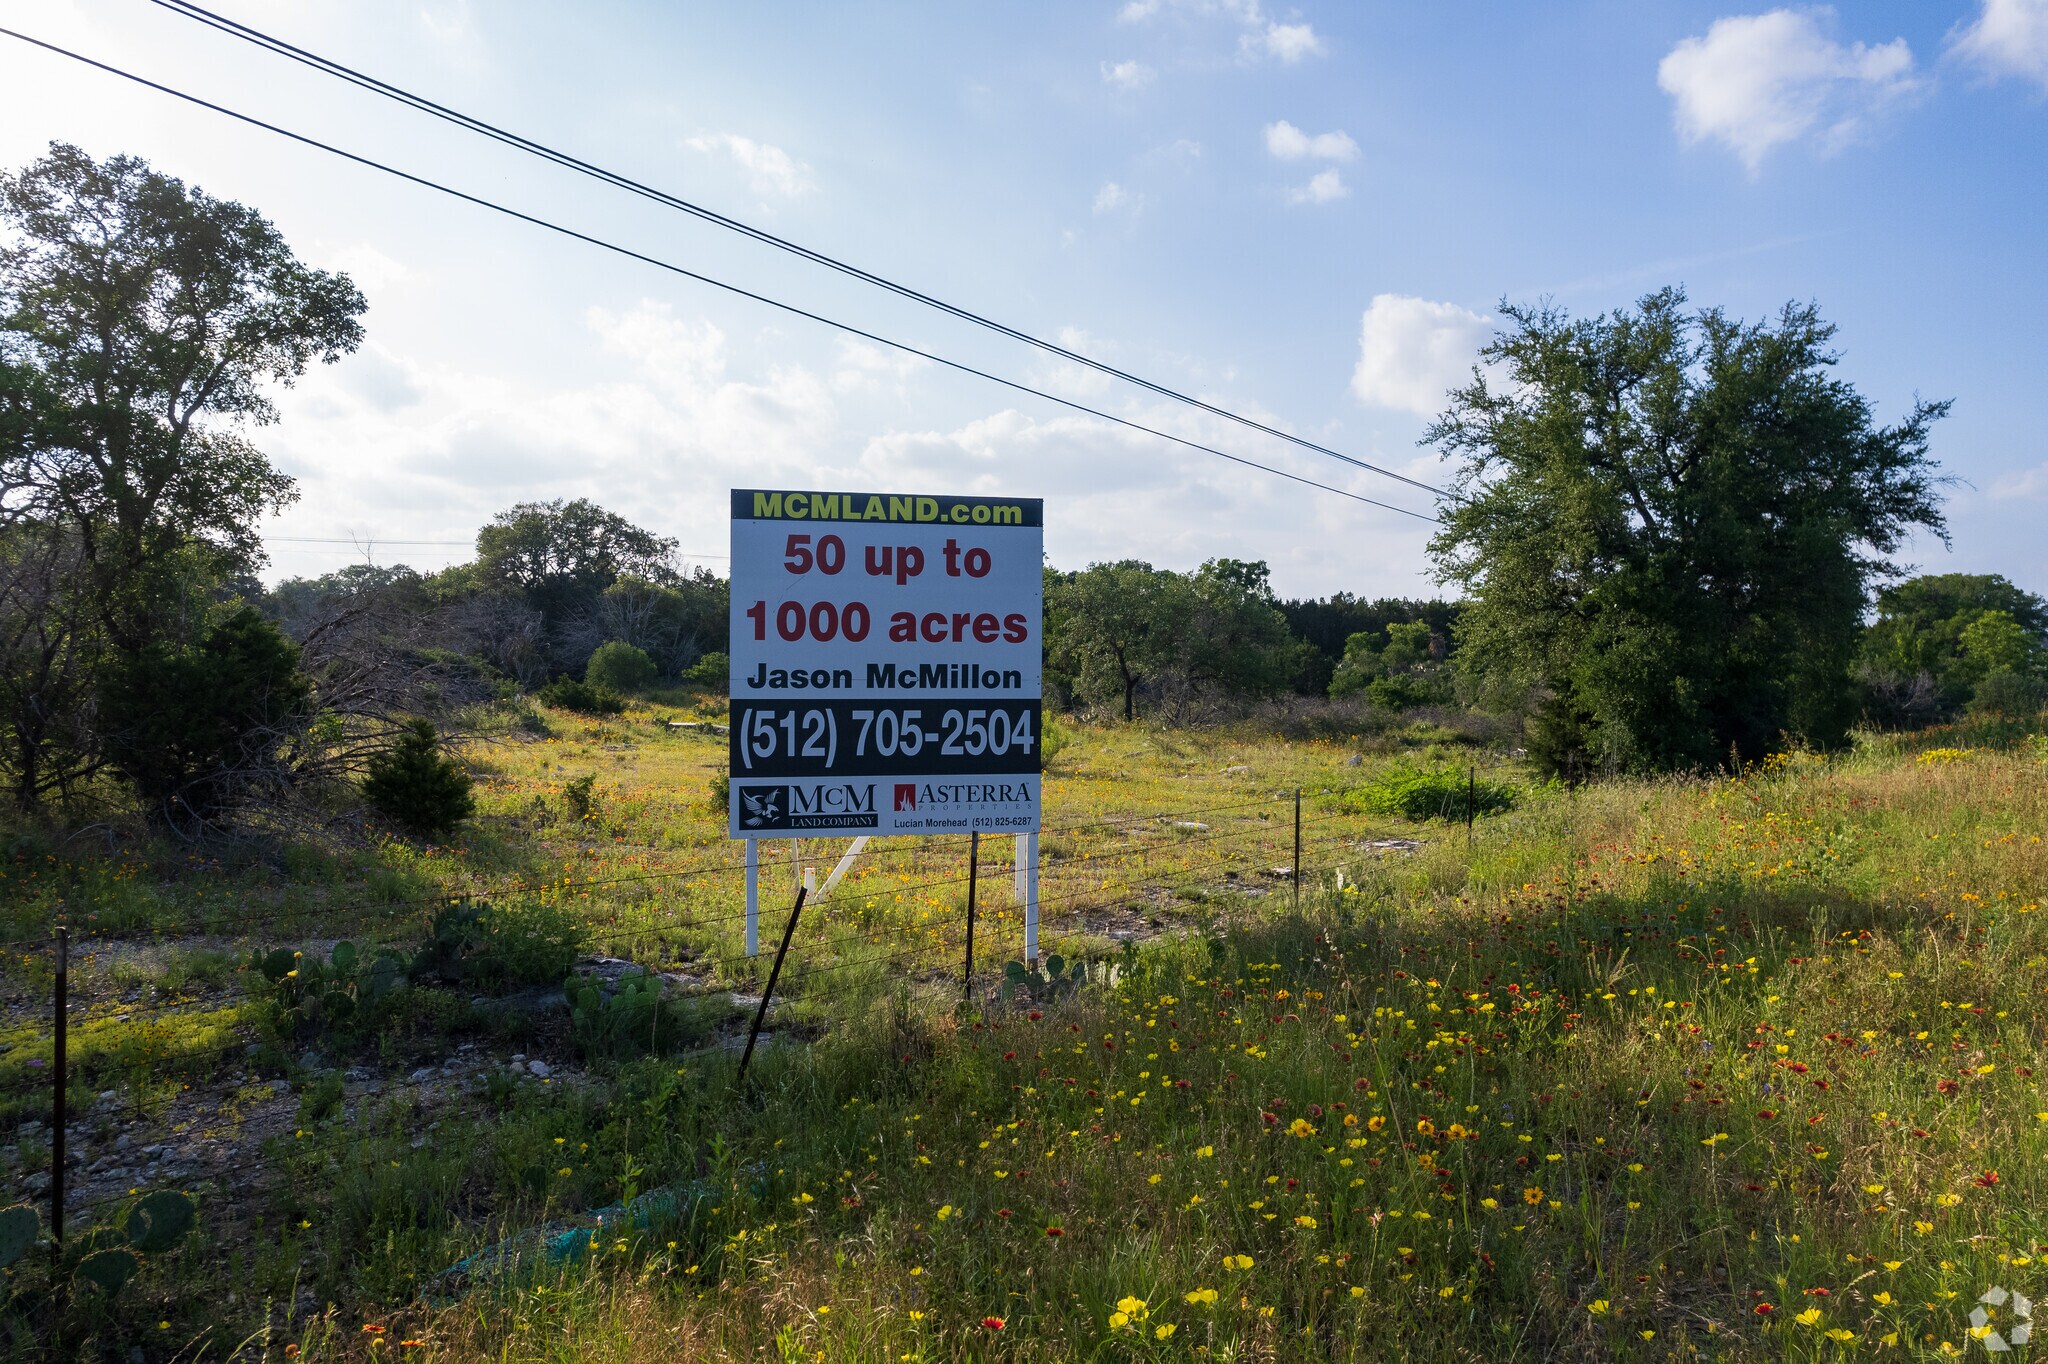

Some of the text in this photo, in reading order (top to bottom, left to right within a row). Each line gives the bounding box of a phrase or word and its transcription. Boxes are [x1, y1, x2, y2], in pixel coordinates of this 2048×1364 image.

[753, 492, 1022, 524] MCMLAND.com
[784, 534, 992, 586] 50 up to
[746, 600, 1028, 643] 1000 acres
[747, 663, 1022, 689] Jason McMillon
[740, 708, 1034, 769] (512) 705-2504
[791, 816, 875, 827] LAND COMPANY
[918, 803, 1032, 811] PROPERTIES
[894, 816, 1032, 828] Lucian Morehead (512) 825-6287
